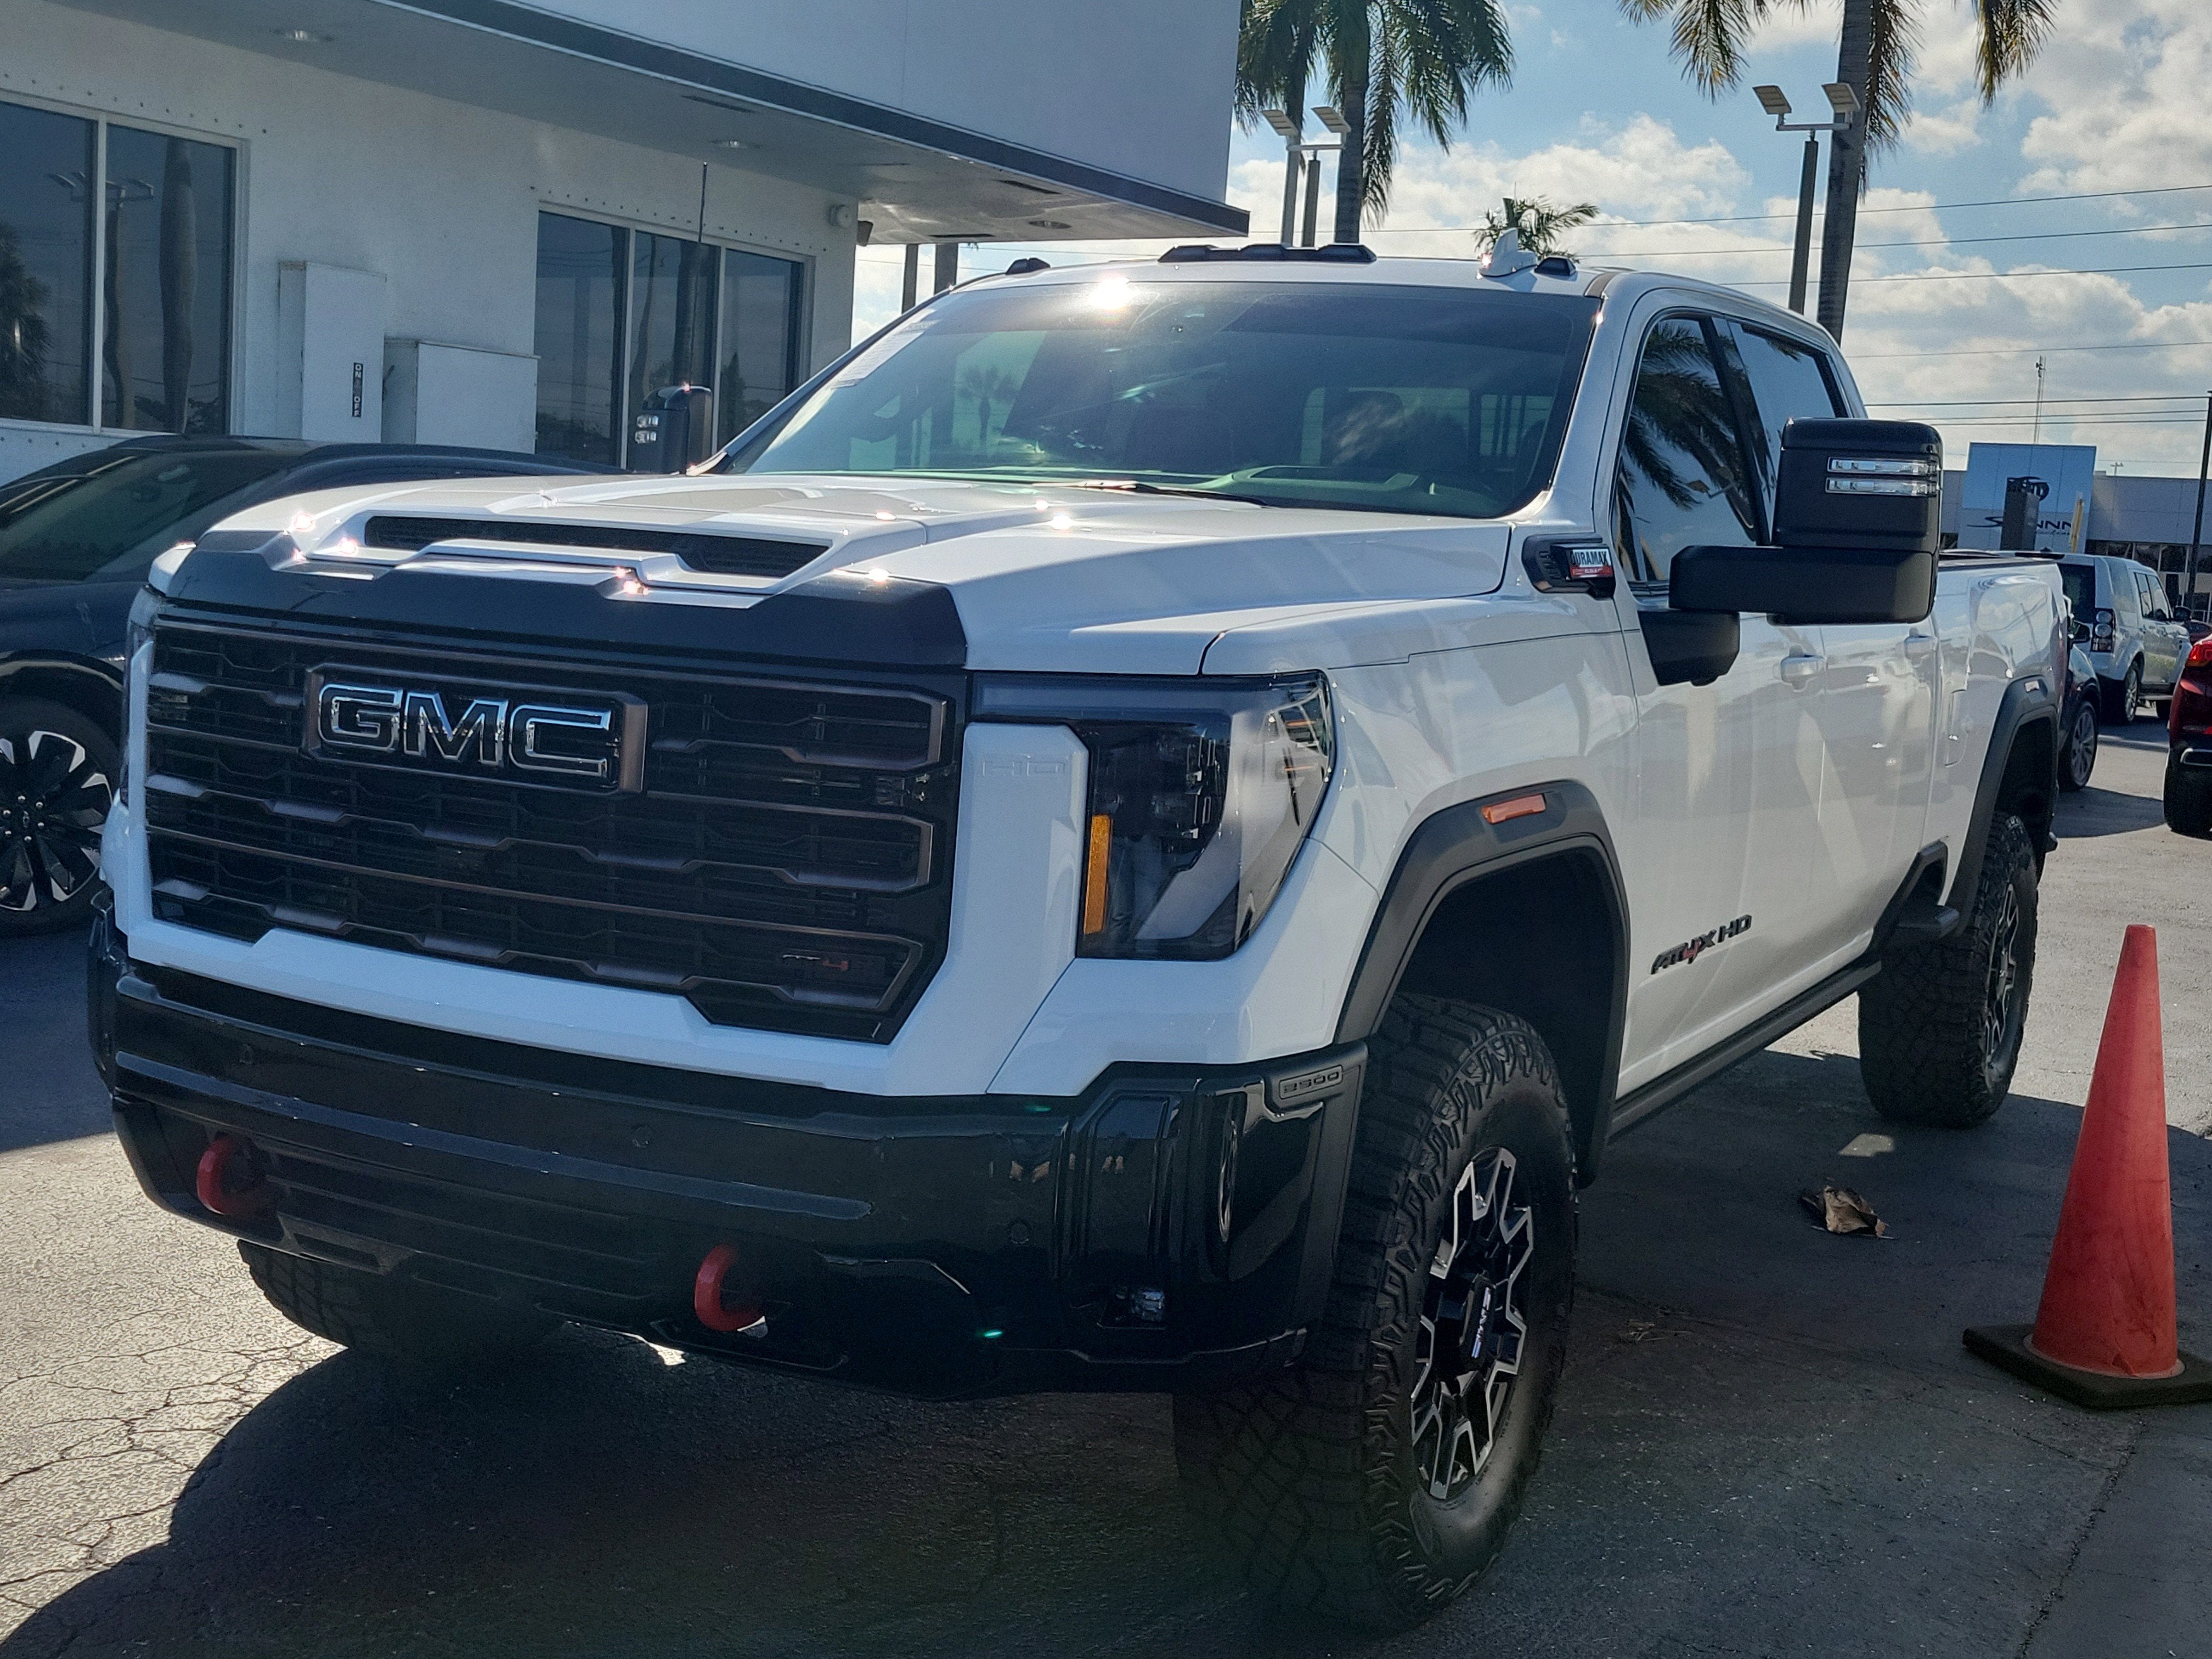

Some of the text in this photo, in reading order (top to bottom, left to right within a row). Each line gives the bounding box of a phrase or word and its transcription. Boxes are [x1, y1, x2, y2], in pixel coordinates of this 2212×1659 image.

[355, 364, 362, 379] ON
[1570, 551, 1609, 566] DURAMAX
[317, 683, 612, 777] GMC
[1718, 914, 1753, 943] HD
